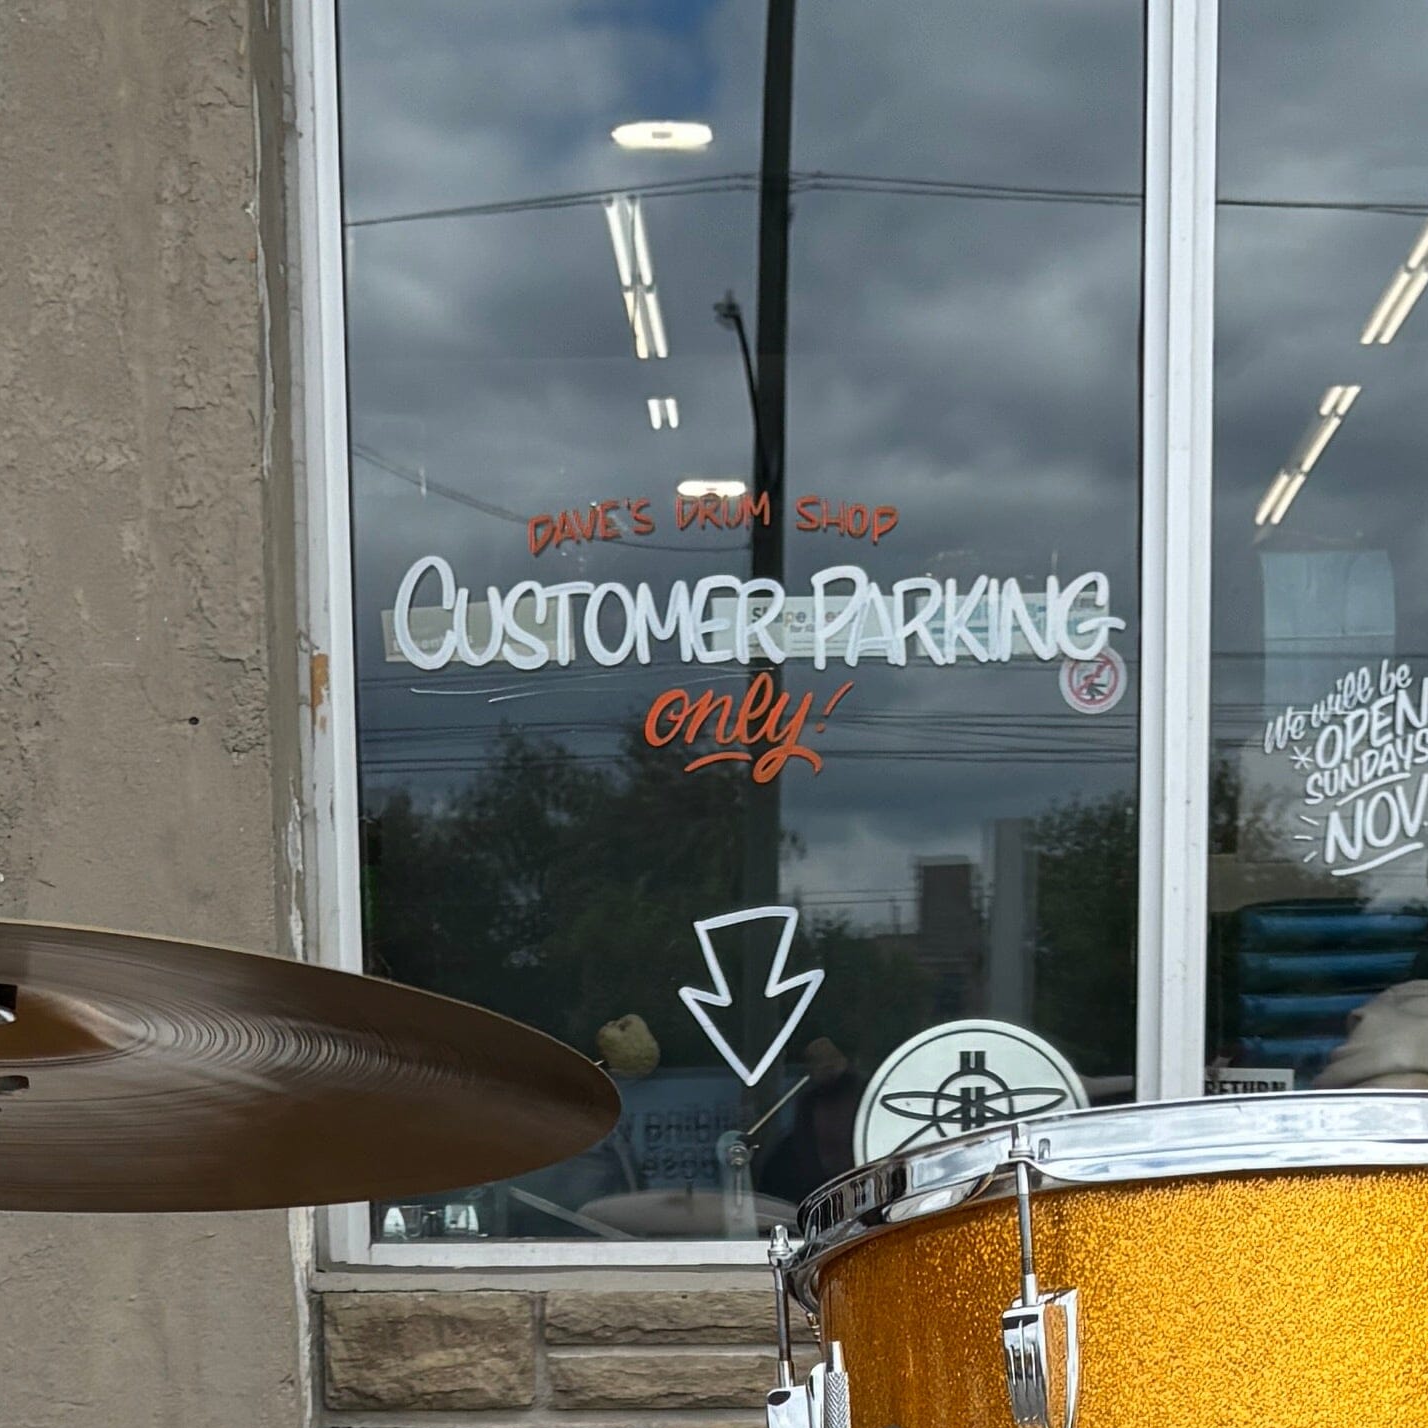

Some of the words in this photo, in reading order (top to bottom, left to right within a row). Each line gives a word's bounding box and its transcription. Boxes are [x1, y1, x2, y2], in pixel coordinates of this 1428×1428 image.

[527, 498, 655, 556] DAVE'S
[675, 491, 771, 530] DRUM
[795, 495, 899, 545] SHOP
[394, 556, 786, 670] CUSTOMER
[811, 565, 1126, 670] PARKING
[644, 671, 855, 784] only!
[1264, 706, 1307, 754] We
[1312, 667, 1374, 728] will
[1380, 659, 1412, 696] be
